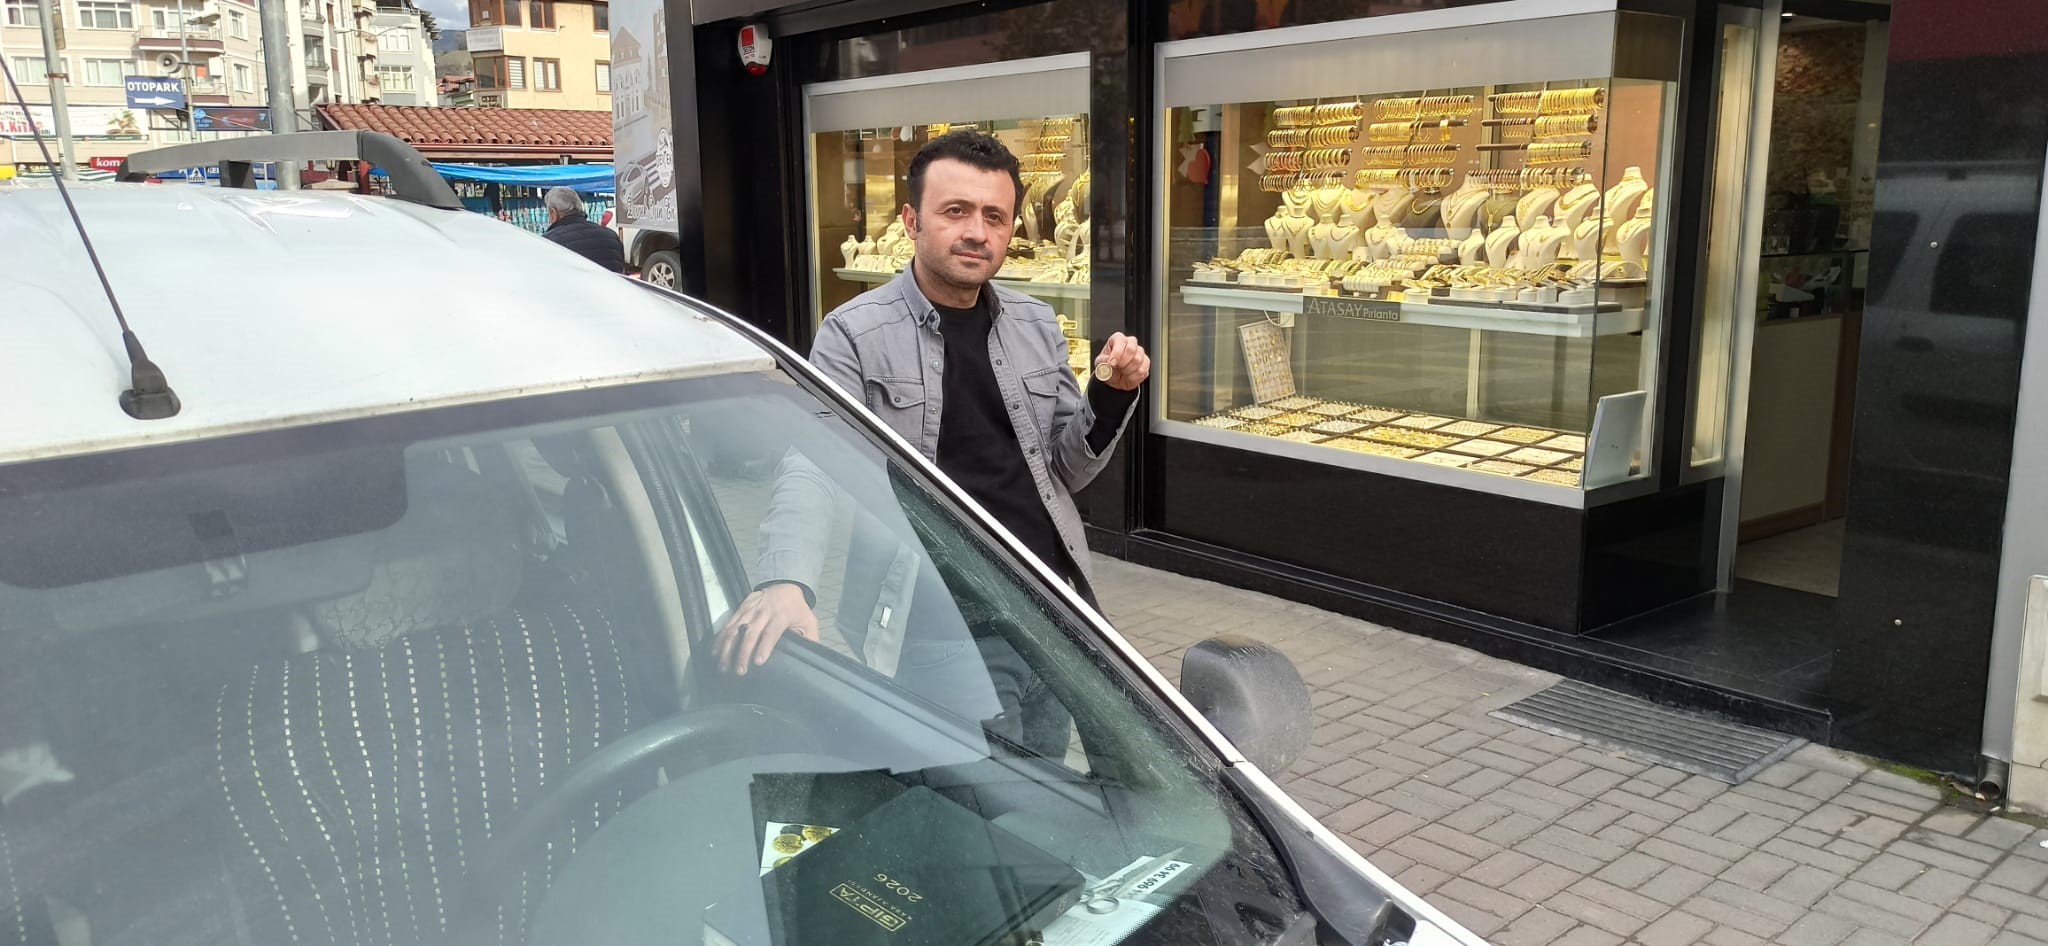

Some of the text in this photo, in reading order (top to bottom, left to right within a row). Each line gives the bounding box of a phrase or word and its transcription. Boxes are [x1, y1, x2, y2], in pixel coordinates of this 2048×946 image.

[127, 81, 180, 93] OTOPARK
[96, 157, 124, 167] kom
[1308, 297, 1363, 317] ATASAY
[873, 872, 923, 903] 2026
